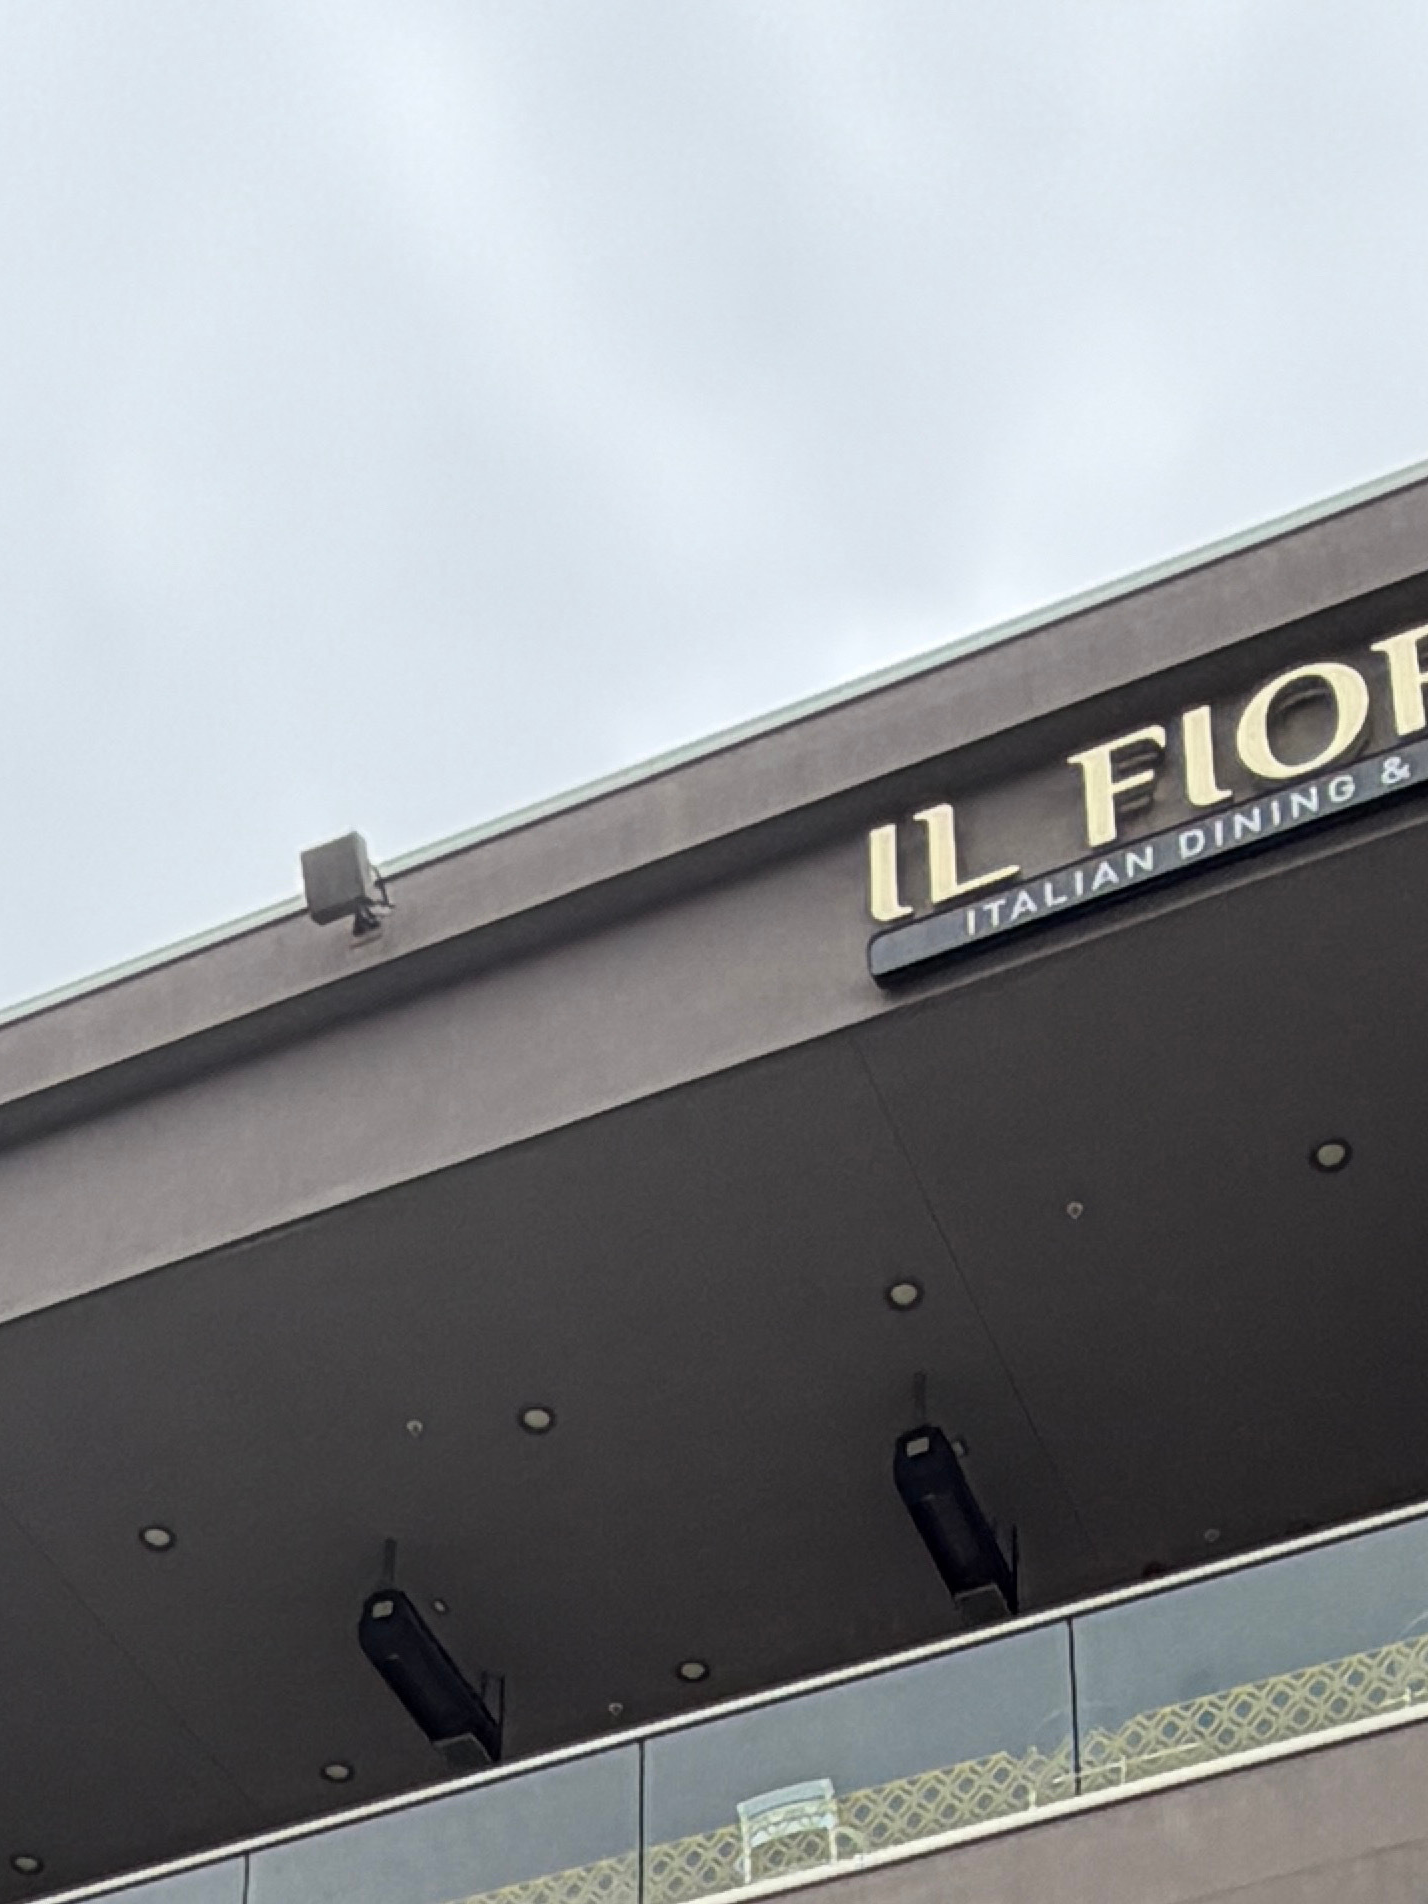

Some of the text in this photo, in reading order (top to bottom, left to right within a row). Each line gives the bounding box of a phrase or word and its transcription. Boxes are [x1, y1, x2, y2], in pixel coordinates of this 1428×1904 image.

[868, 804, 1021, 923] IL
[964, 844, 1155, 936] ITALIAN
[1178, 775, 1358, 859] DINING
[1380, 755, 1411, 787] &
